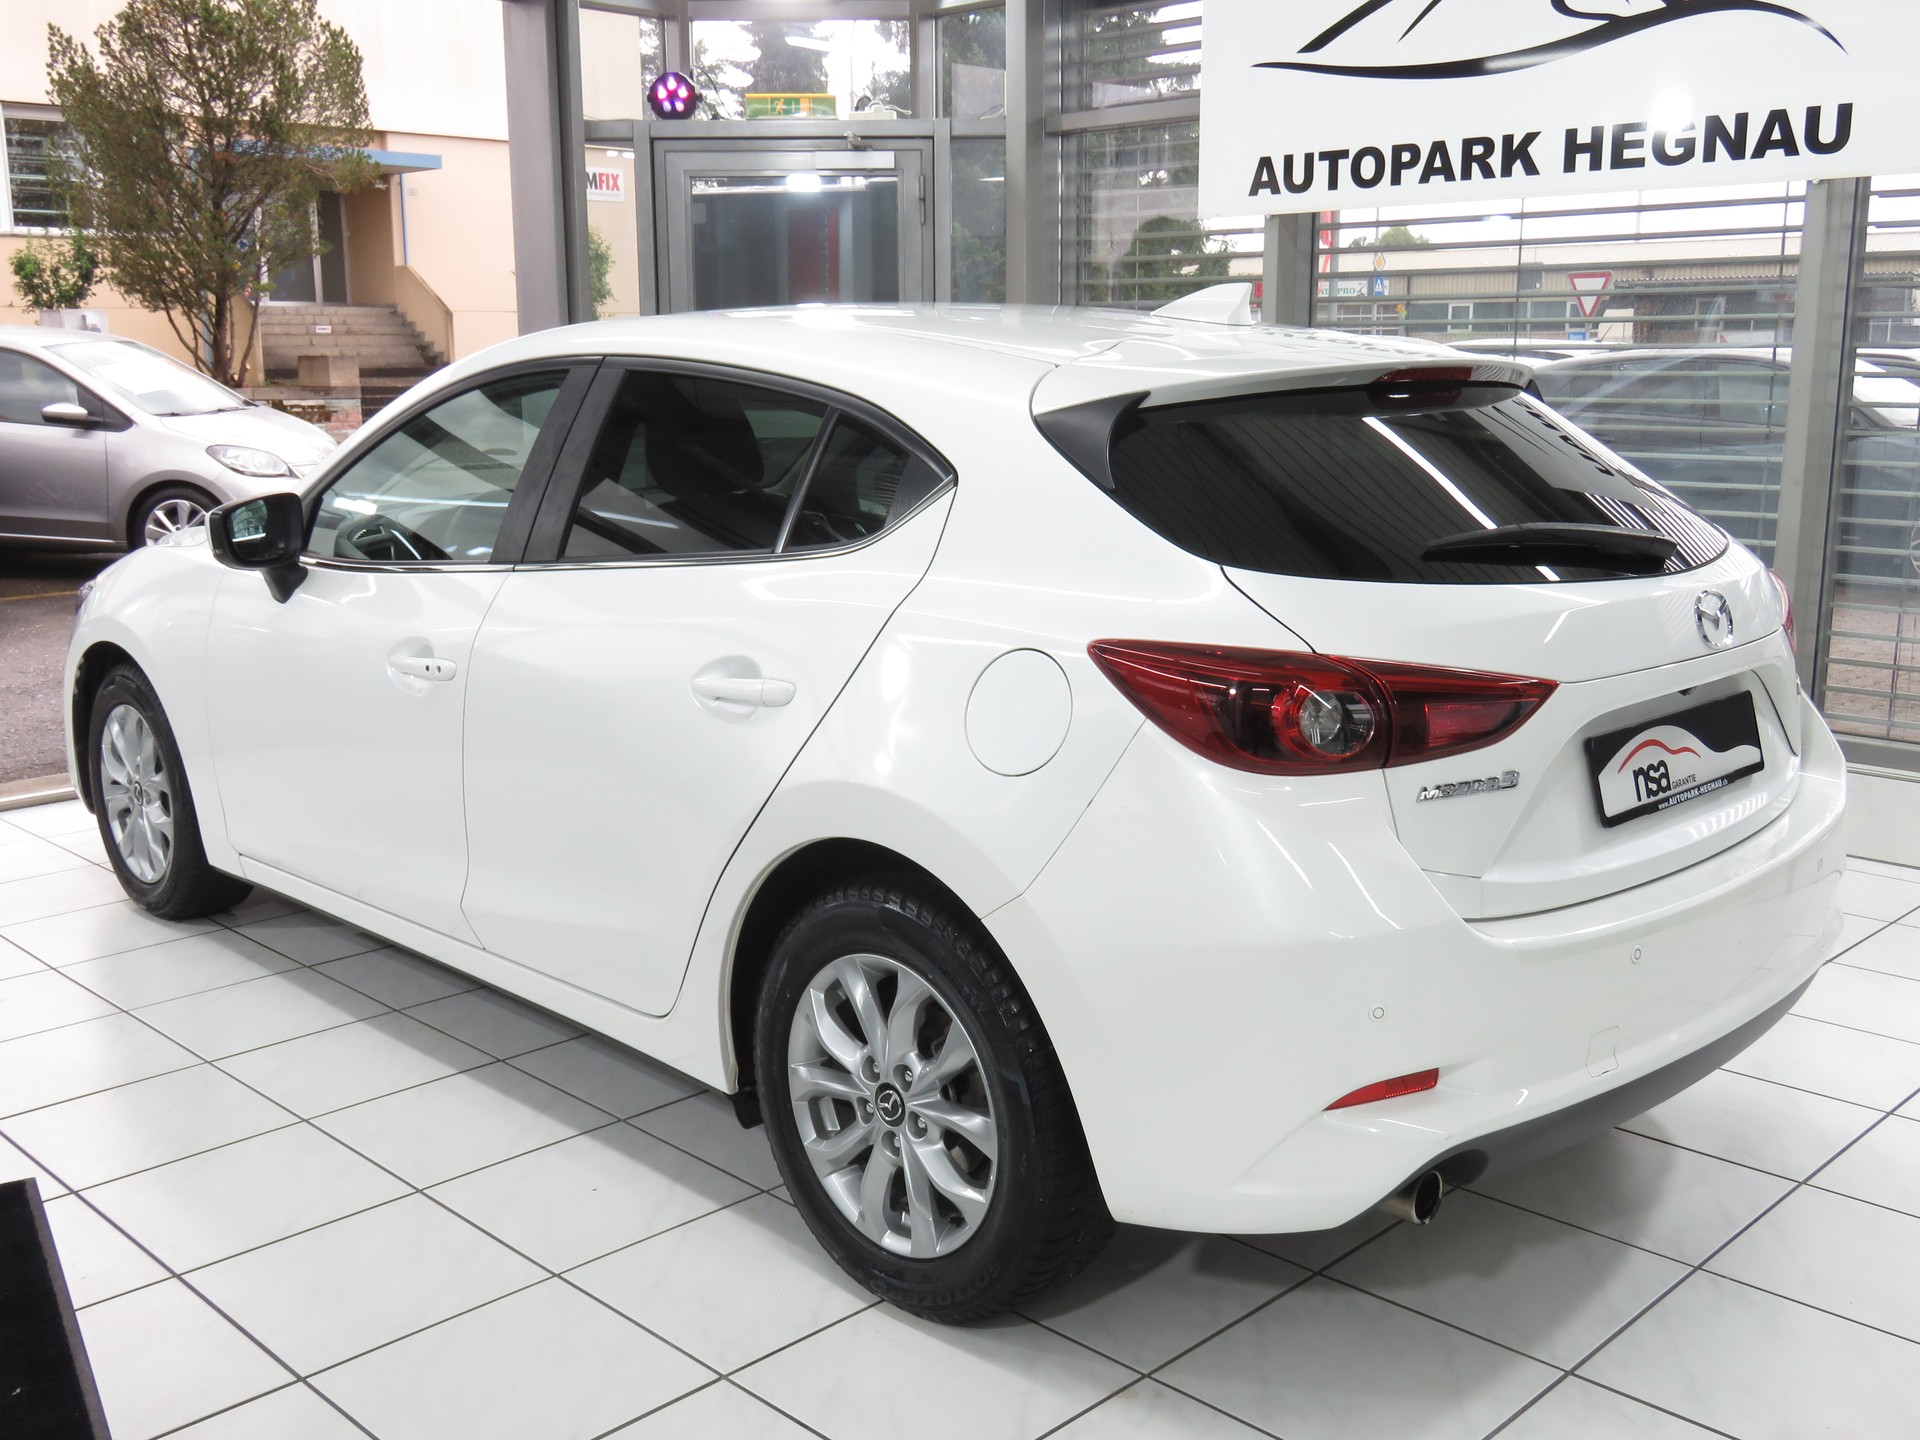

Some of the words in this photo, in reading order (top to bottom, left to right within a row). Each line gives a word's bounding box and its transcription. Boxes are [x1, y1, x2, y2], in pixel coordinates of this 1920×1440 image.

[1248, 131, 1542, 197] AUTOPARK
[1563, 103, 1853, 173] HEGNAU
[1632, 759, 1672, 802] nsa
[1657, 778, 1729, 810] www.AUTOPARK-HEGNAU.ch
[1671, 773, 1697, 790] GARANTIE
